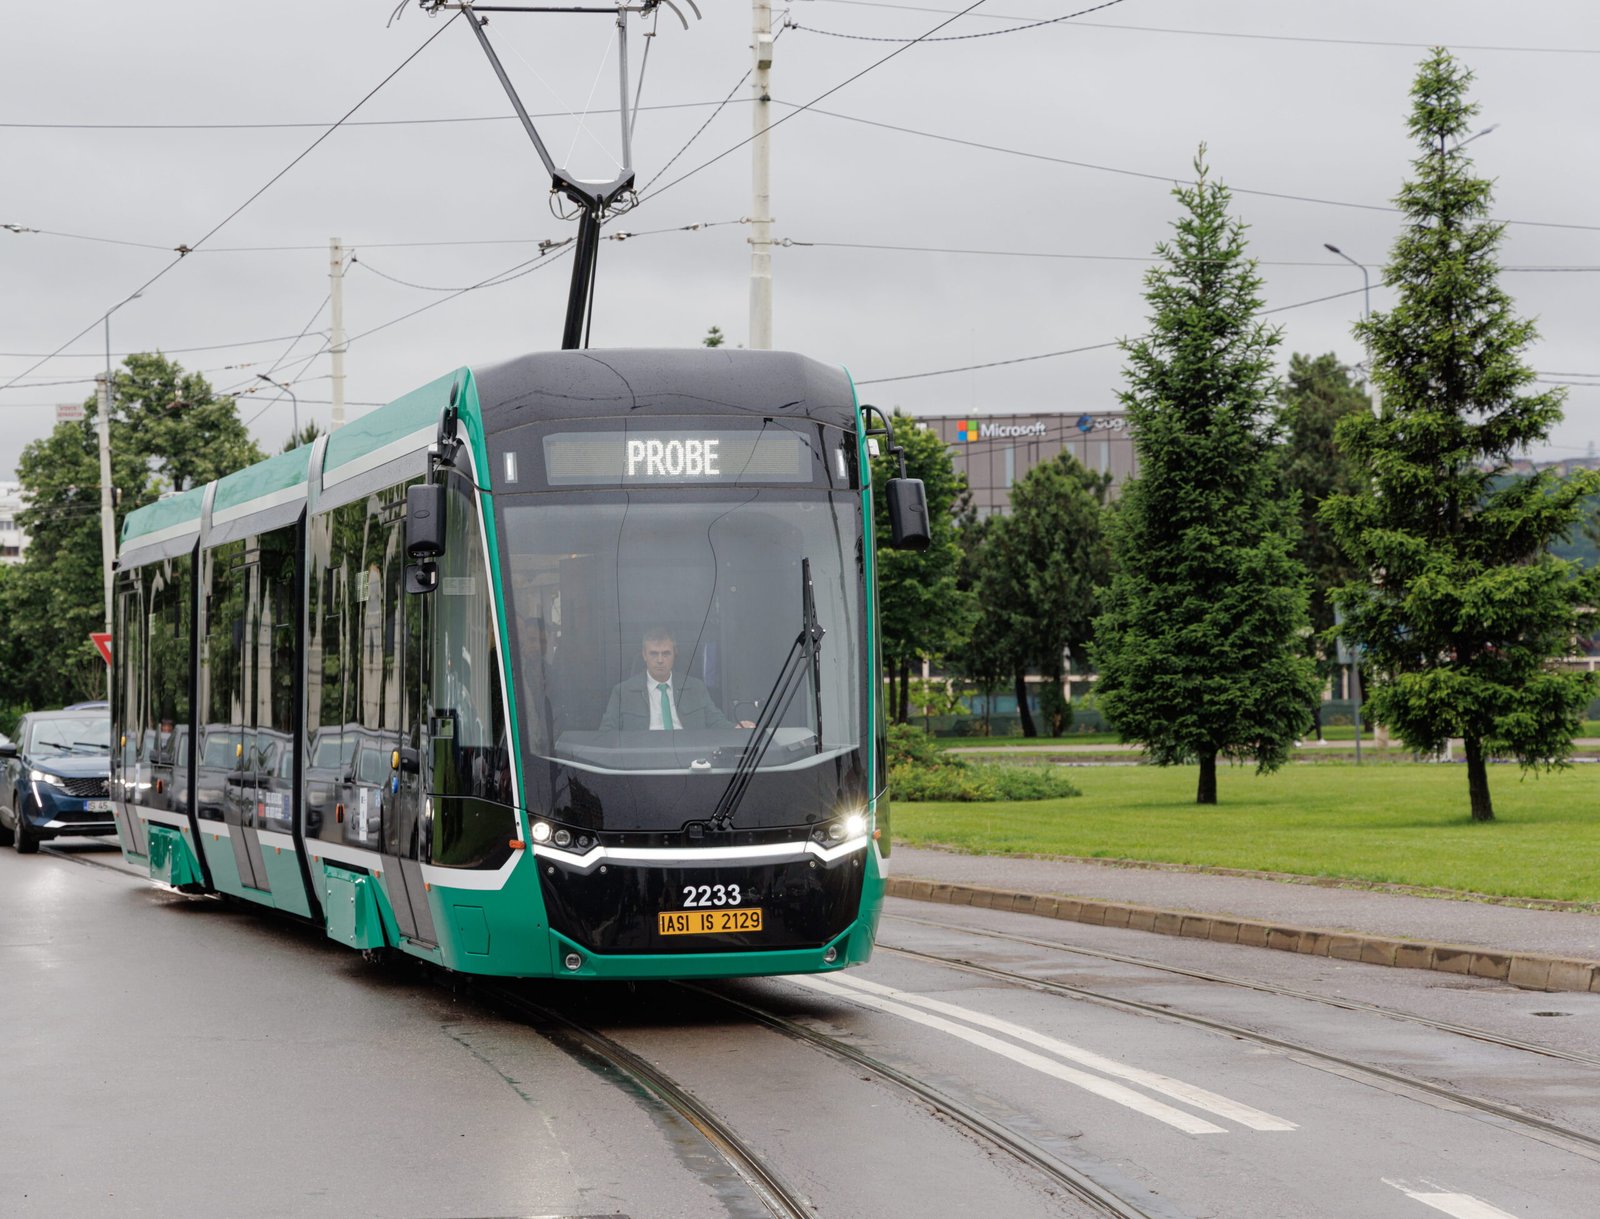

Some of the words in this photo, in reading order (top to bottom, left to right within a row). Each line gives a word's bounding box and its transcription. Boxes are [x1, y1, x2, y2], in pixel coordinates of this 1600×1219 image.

[980, 421, 1046, 437] Microsoft
[628, 439, 720, 475] PROBE
[682, 884, 742, 907] 2233
[661, 915, 690, 932] IASI
[701, 914, 714, 931] IS
[721, 912, 760, 930] 2129
